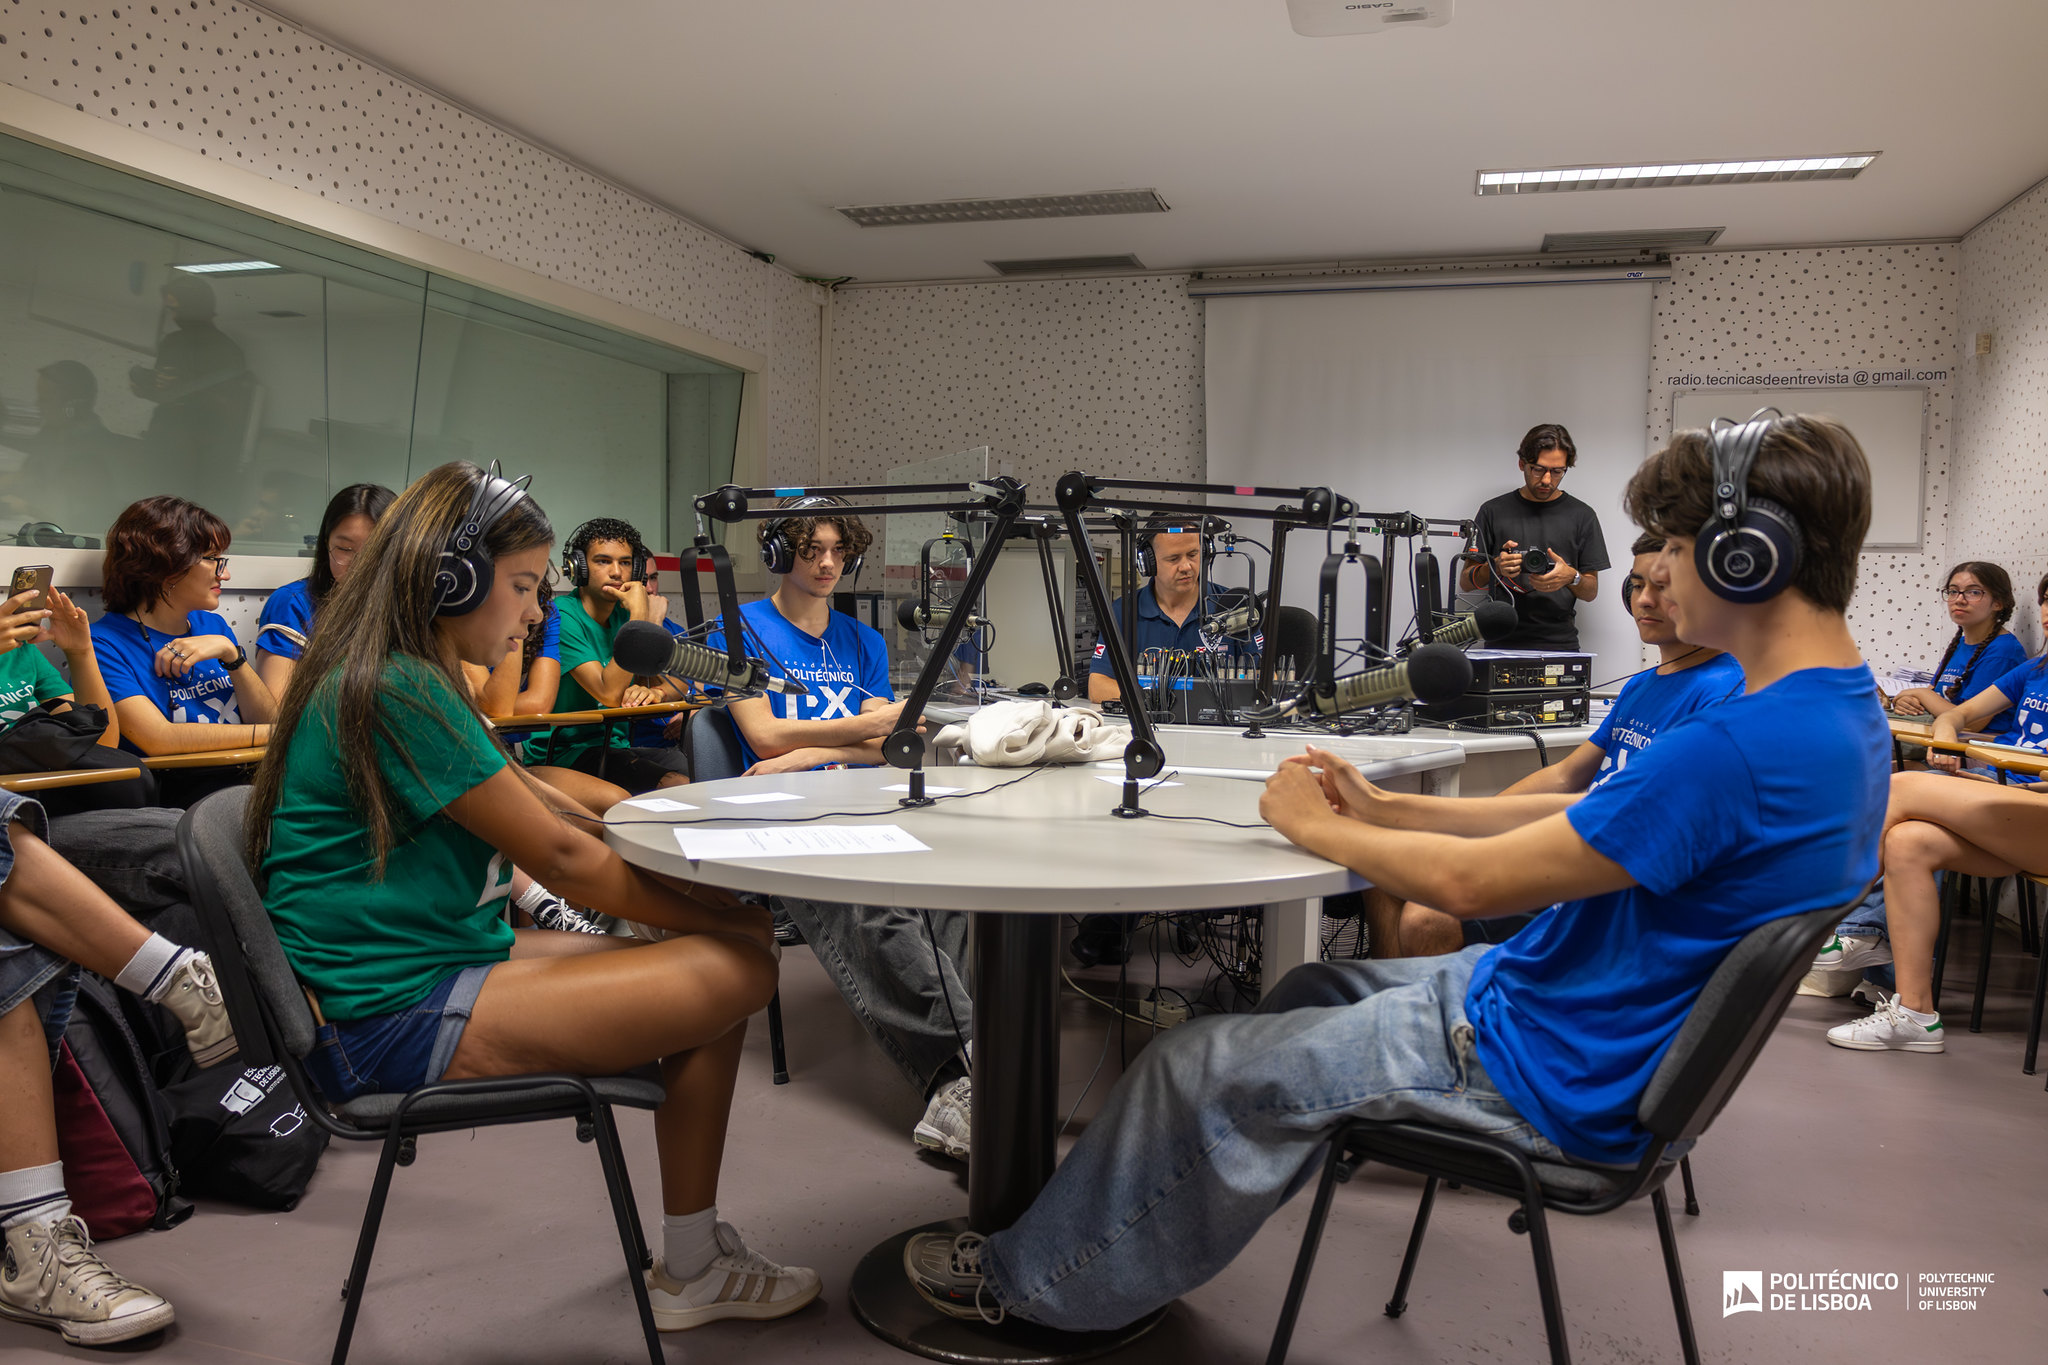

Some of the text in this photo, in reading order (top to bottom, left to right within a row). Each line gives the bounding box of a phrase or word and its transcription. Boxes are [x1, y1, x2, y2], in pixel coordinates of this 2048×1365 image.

[1345, 2, 1394, 10] CASIO
[1667, 368, 1948, 386] radio.tecnicasdeentrevista @ gmail.com
[784, 668, 854, 683] POLITÉCNICO
